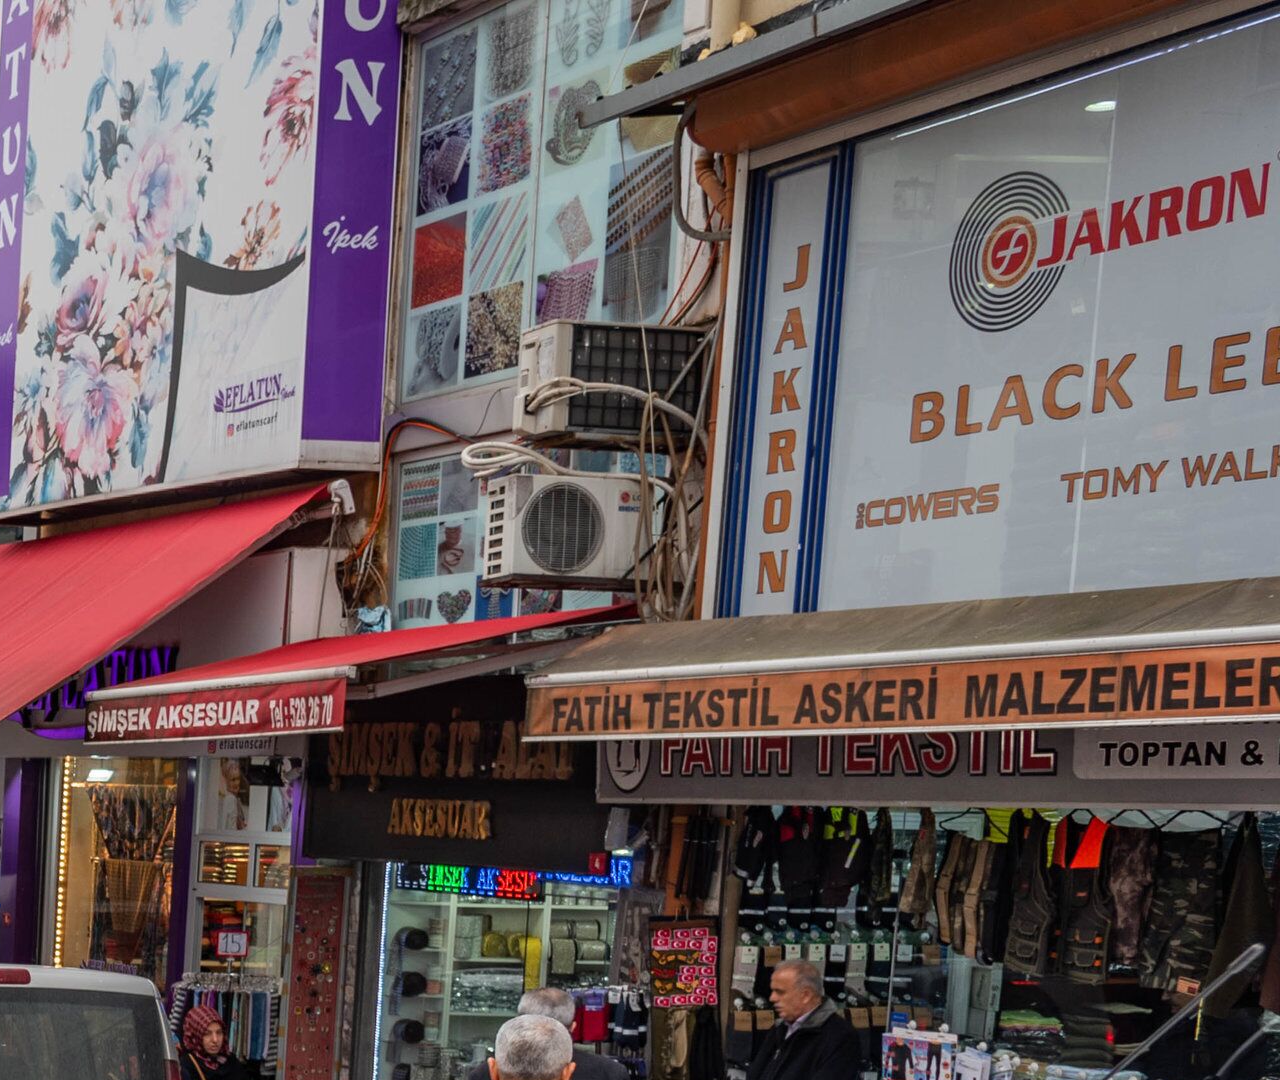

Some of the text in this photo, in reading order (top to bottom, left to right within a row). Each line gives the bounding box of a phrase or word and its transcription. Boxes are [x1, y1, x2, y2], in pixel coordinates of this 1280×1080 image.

[323, 215, 380, 254] İpek
[1037, 162, 1271, 268] JAKRON
[225, 373, 282, 409] EFLATUN
[909, 353, 1137, 444] BLACK
[756, 243, 811, 596] JAKRON
[1060, 460, 1170, 503] TOMY
[865, 483, 1000, 528] COWERS
[87, 706, 151, 738] ŞİMŞEK
[155, 699, 260, 730] AKSESUAR
[322, 694, 334, 725] 70
[551, 684, 633, 733] FATİH
[642, 678, 780, 730] TEKSTİL
[793, 665, 938, 723] ASKERİ
[1099, 739, 1264, 767] TOPTAN &
[387, 797, 491, 841] AKSESUAR
